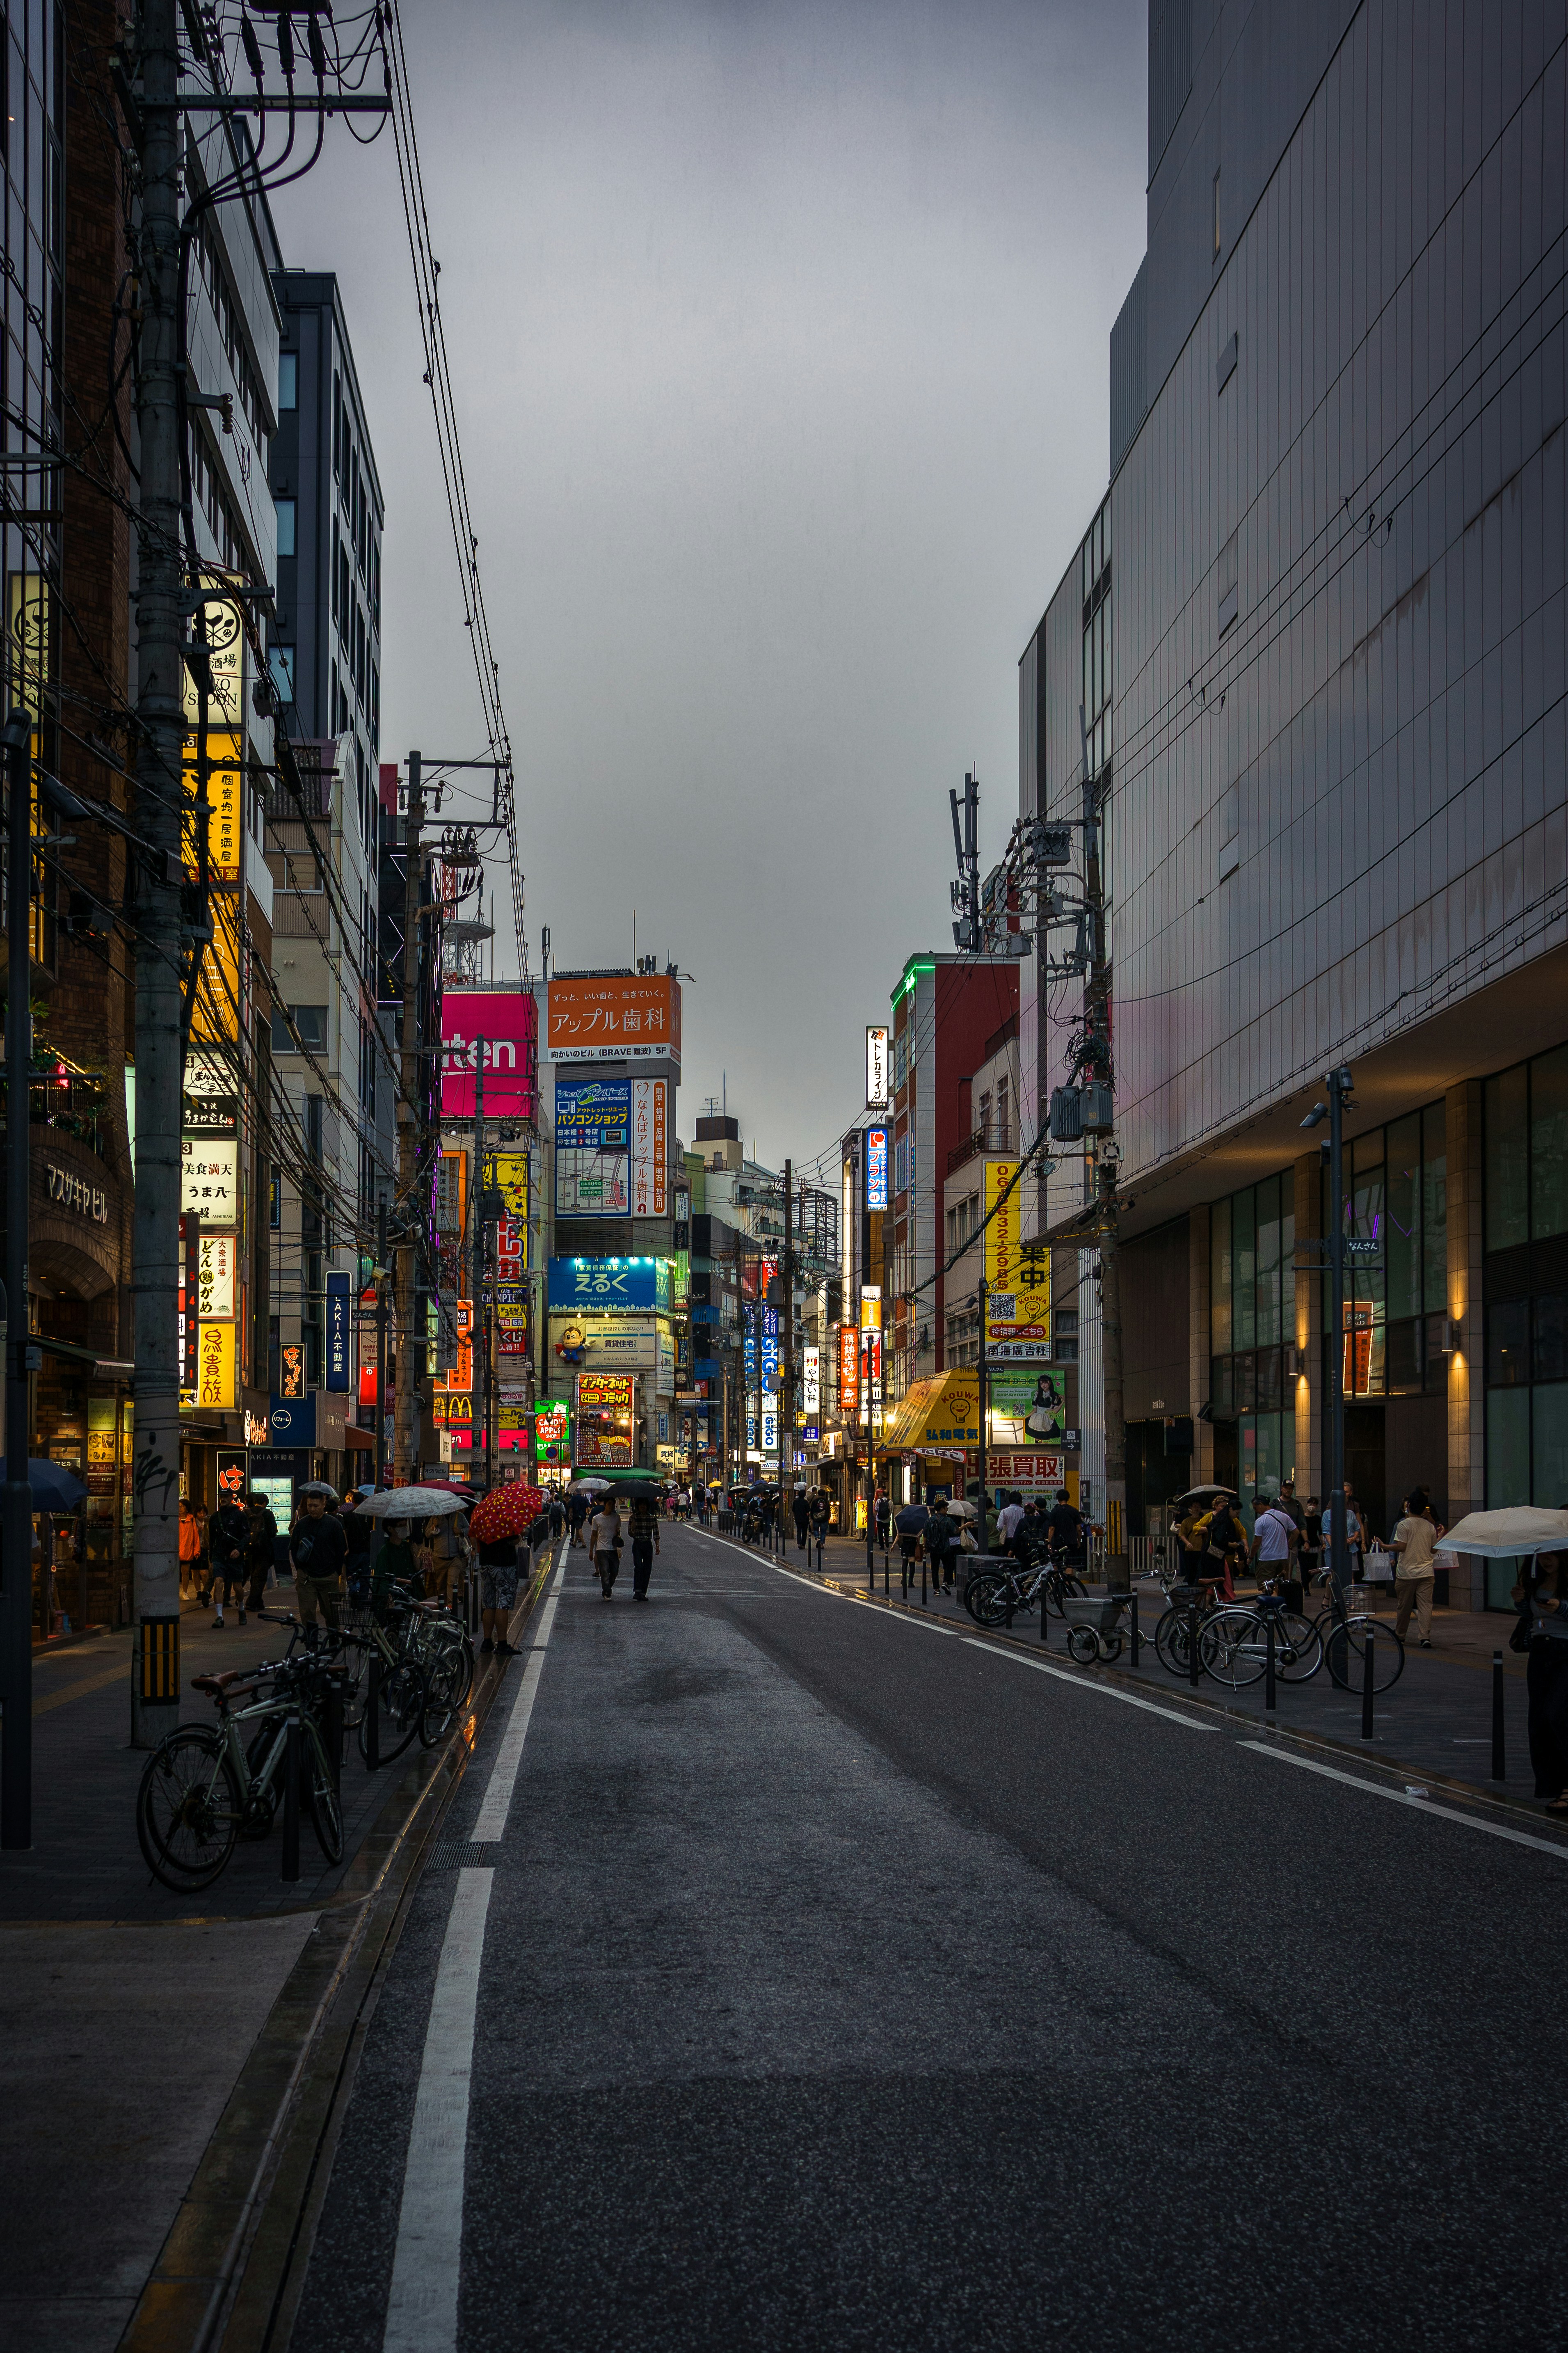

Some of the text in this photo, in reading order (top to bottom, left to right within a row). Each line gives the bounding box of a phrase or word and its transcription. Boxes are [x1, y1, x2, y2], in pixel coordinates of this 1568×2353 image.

[208, 654, 237, 669] 酒場
[187, 694, 238, 706] SOON
[187, 737, 195, 747] 6
[221, 775, 233, 862] 個室均一居酒屋
[552, 1008, 665, 1032] アップル歯科
[186, 1057, 193, 1067] 4
[558, 1113, 628, 1125] パソコンショップ
[183, 1144, 190, 1153] 3
[637, 1099, 648, 1202] なんばアップル歯科
[183, 1163, 232, 1175] 美食満天
[869, 1149, 880, 1190] プラン
[189, 1186, 227, 1198] うま八
[1349, 1242, 1378, 1250] なんさん
[218, 1241, 226, 1277] 大衆酒場
[190, 1272, 195, 1280] 5
[575, 1274, 629, 1293] えるく
[189, 1296, 195, 1305] 4
[1018, 1296, 1047, 1305] KOUWA
[189, 1320, 194, 1330] 3
[189, 1345, 194, 1354] 2
[988, 1346, 1046, 1356] 南海廣告社
[843, 1334, 857, 1383] 情熱ホルモン
[203, 1329, 222, 1403] 鳥貴族
[283, 1346, 301, 1396] はなまるうどん
[190, 1369, 193, 1378] 1
[581, 1377, 630, 1389] インターネット
[807, 1369, 816, 1403] やよい軒
[601, 1392, 629, 1403] コミック
[941, 1391, 979, 1403] KOUWA
[926, 1428, 978, 1441] 弘和電気
[967, 1456, 1058, 1478] 出張買取
